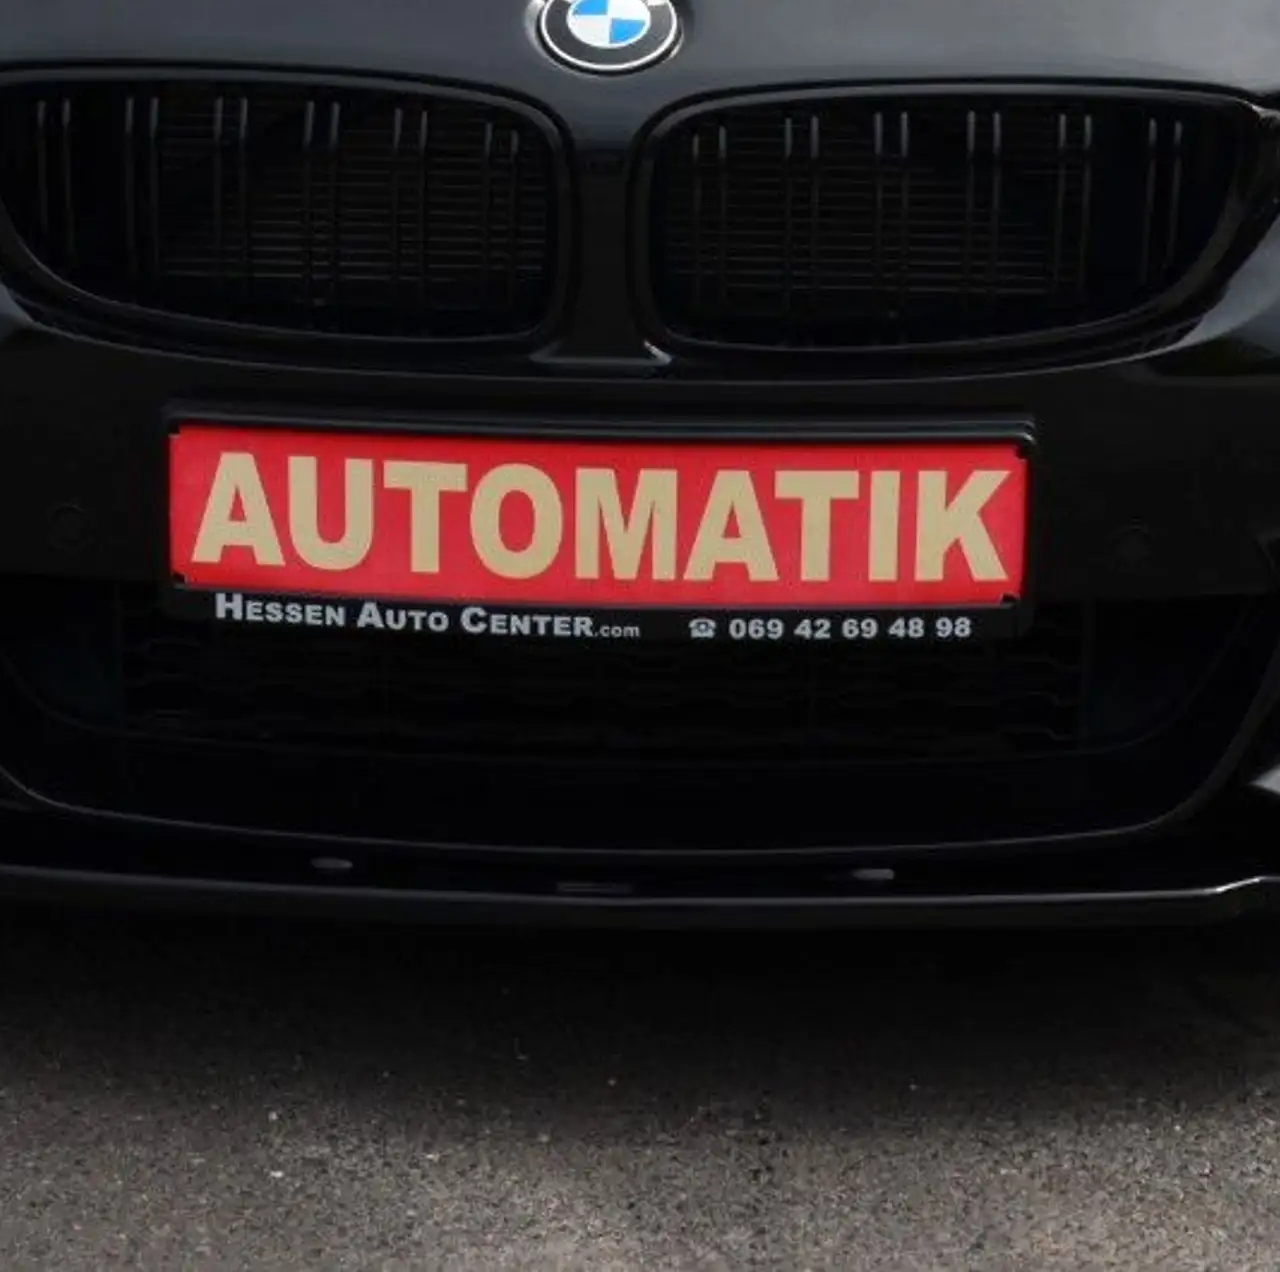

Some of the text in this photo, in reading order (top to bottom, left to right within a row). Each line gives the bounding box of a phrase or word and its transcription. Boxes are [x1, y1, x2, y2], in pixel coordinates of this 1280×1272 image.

[191, 449, 1013, 584] AUTOMATIK
[214, 591, 346, 628] HESSEN
[356, 601, 450, 633] AUTO
[728, 618, 785, 640] 069
[793, 618, 831, 640] 42
[841, 618, 879, 640] 69
[888, 617, 925, 639] 48
[935, 616, 971, 638] 98
